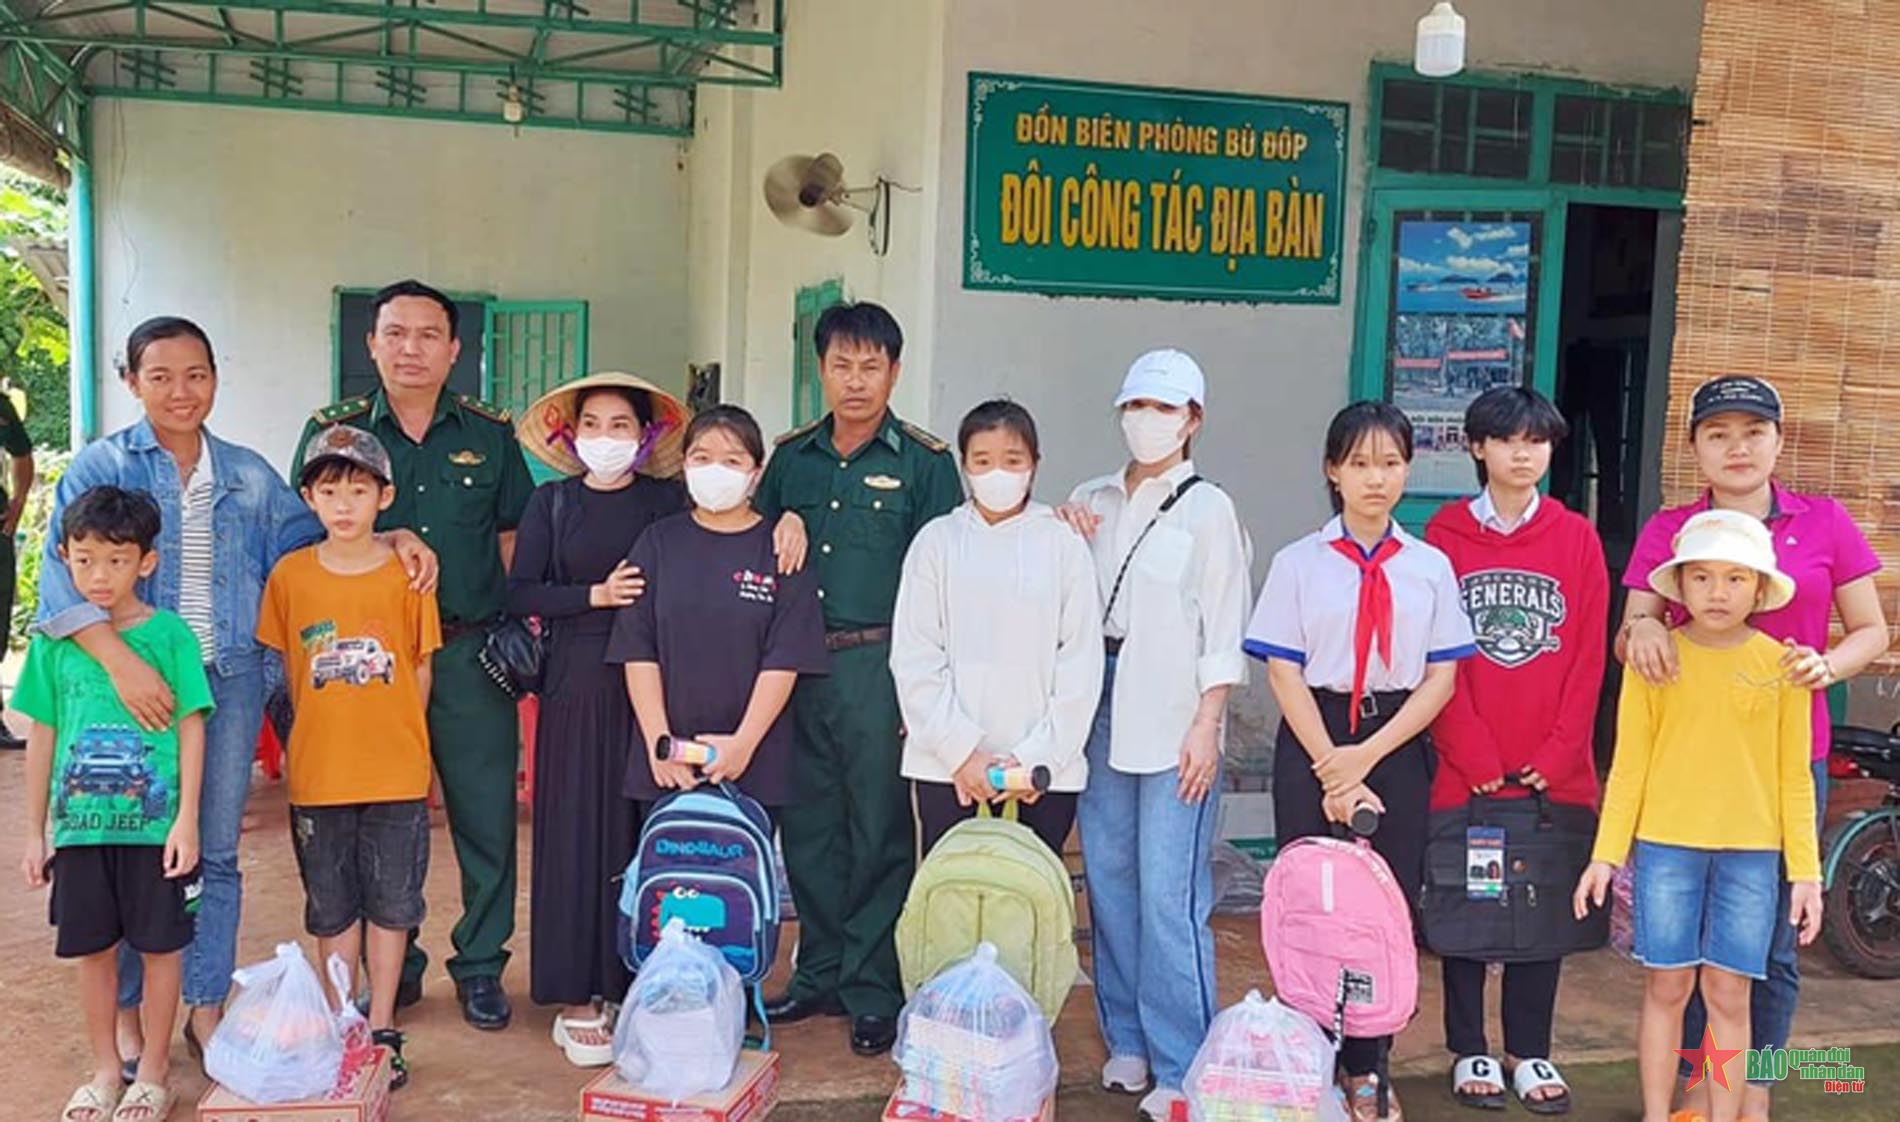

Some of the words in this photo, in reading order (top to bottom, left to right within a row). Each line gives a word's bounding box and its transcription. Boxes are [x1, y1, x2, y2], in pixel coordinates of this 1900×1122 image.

[1075, 112, 1131, 149] BIÊN
[1060, 163, 1141, 250] CÔNG
[1150, 168, 1203, 253] TÁC
[1210, 186, 1257, 272] ĐỊA
[1265, 175, 1324, 258] BÀN
[1472, 1058, 1490, 1077] C
[1532, 1061, 1553, 1080] C
